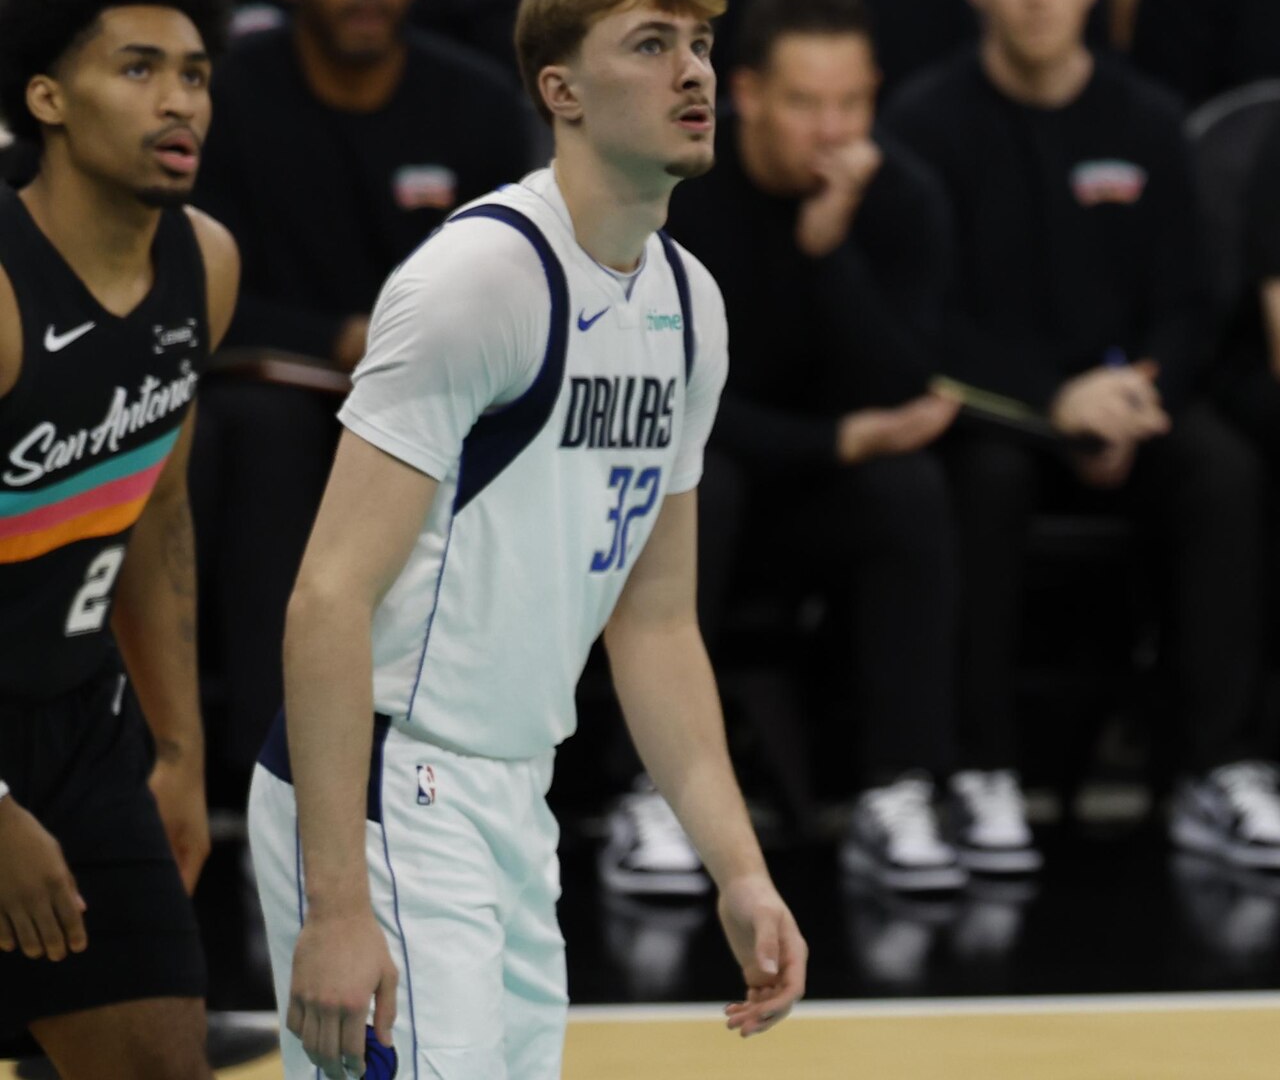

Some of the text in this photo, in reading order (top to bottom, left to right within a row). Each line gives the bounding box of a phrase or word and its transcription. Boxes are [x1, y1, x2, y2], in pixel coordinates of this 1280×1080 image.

[2, 421, 88, 487] San
[558, 375, 678, 450] DALLAS
[590, 466, 662, 573] 32
[64, 544, 126, 638] 2
